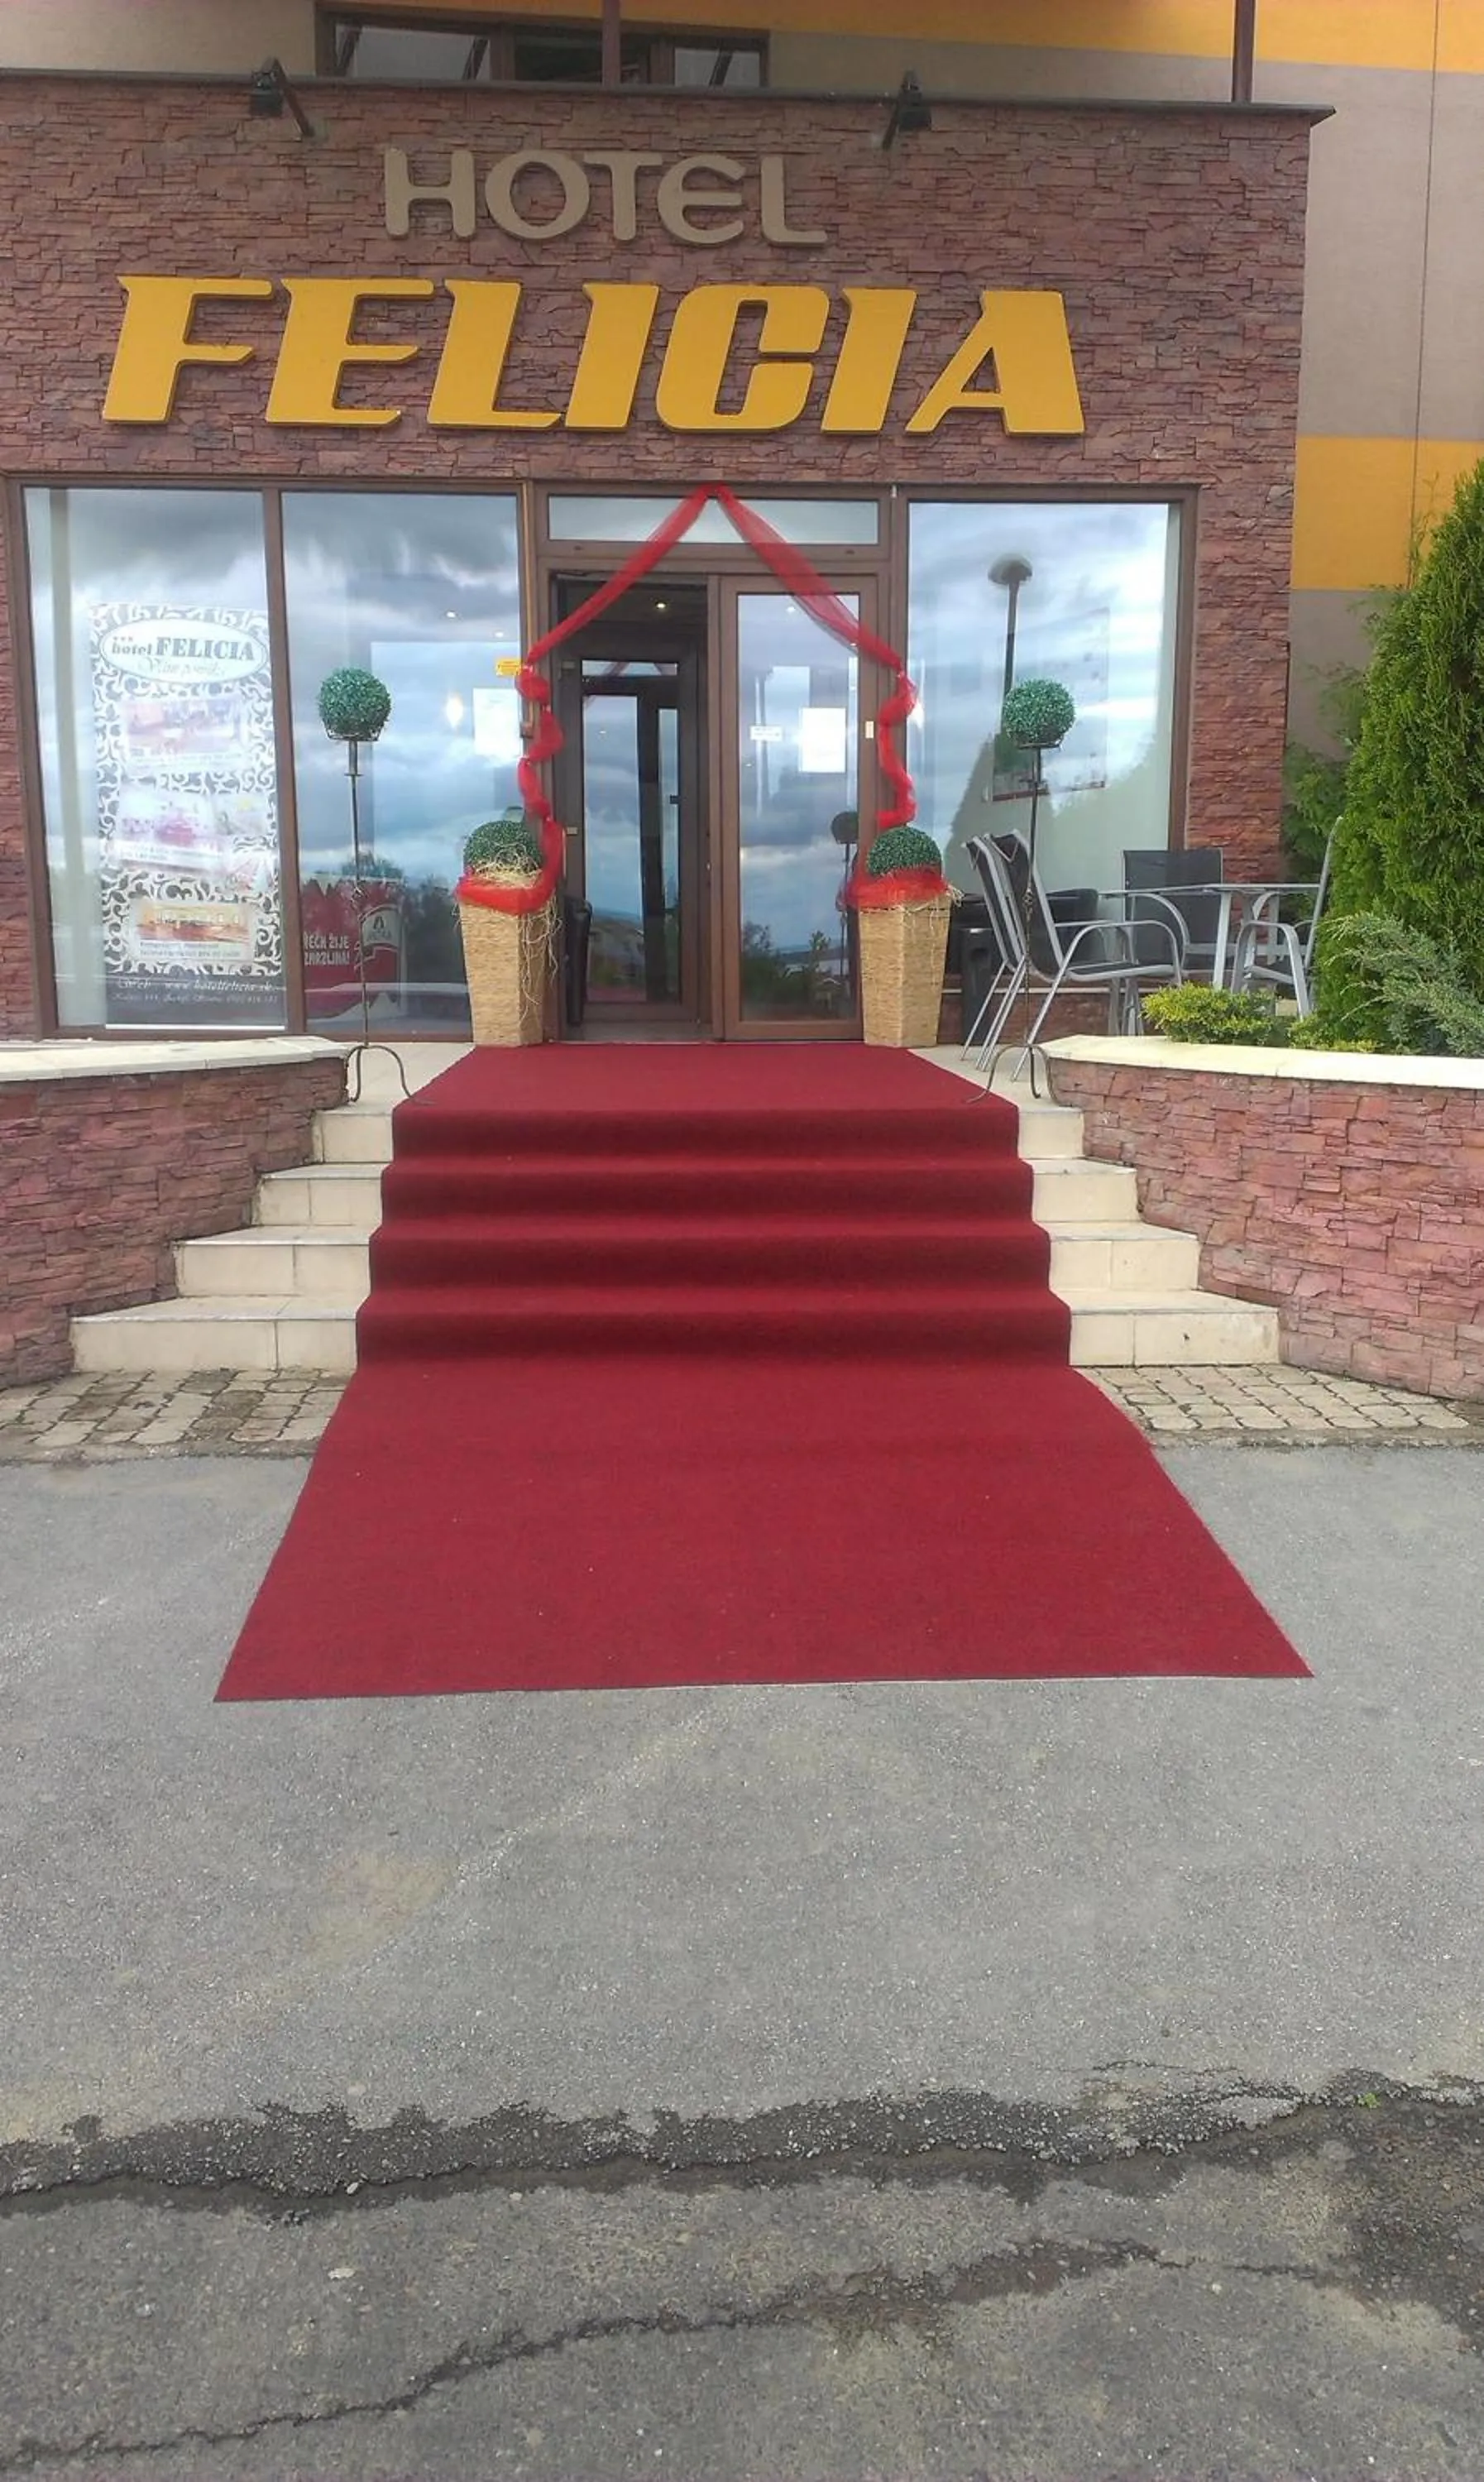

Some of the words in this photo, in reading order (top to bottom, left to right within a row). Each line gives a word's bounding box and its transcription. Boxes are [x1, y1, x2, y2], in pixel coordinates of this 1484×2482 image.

[382, 146, 827, 247] HOTEL
[102, 275, 1086, 437] FELICIA
[112, 642, 152, 656] hotel
[156, 636, 255, 661] FELICIA
